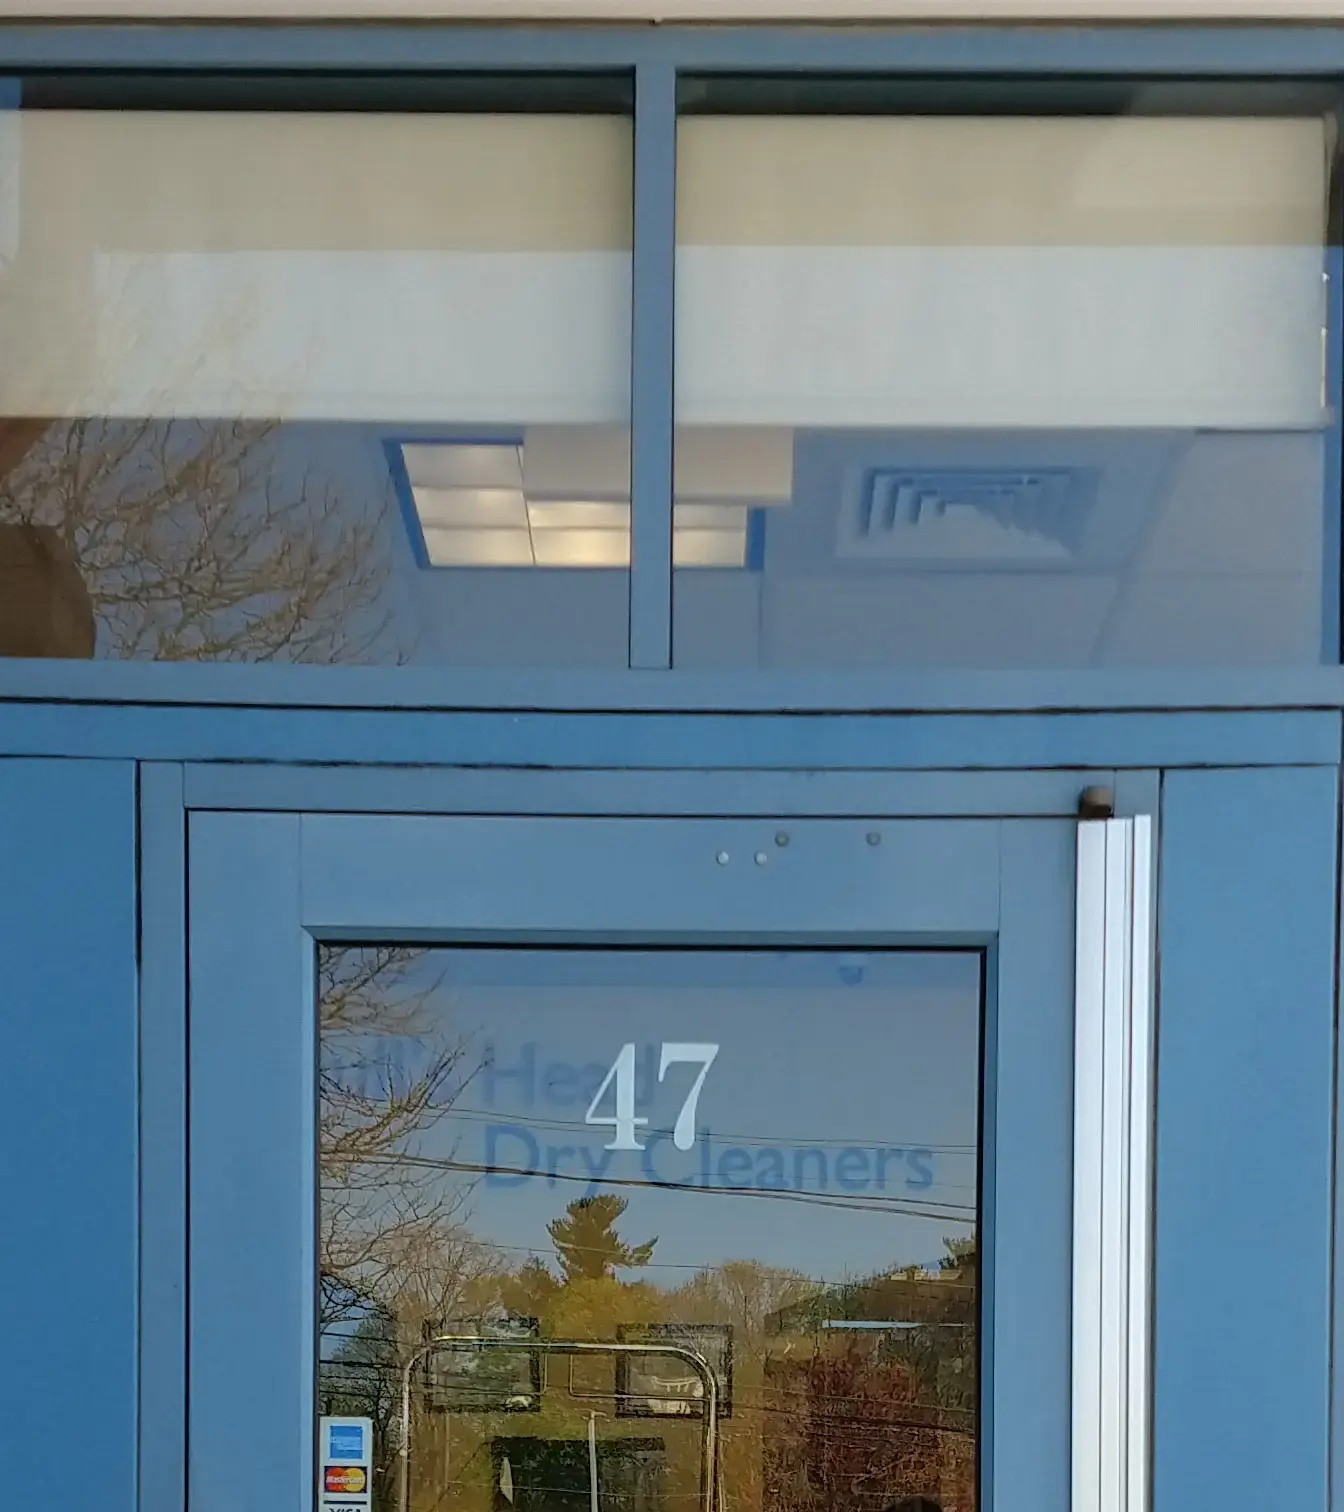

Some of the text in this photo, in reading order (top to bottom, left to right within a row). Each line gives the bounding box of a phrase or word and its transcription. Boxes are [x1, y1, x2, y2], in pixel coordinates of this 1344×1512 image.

[584, 1041, 720, 1151] 47
[484, 1122, 935, 1200] Dry Cleaners
